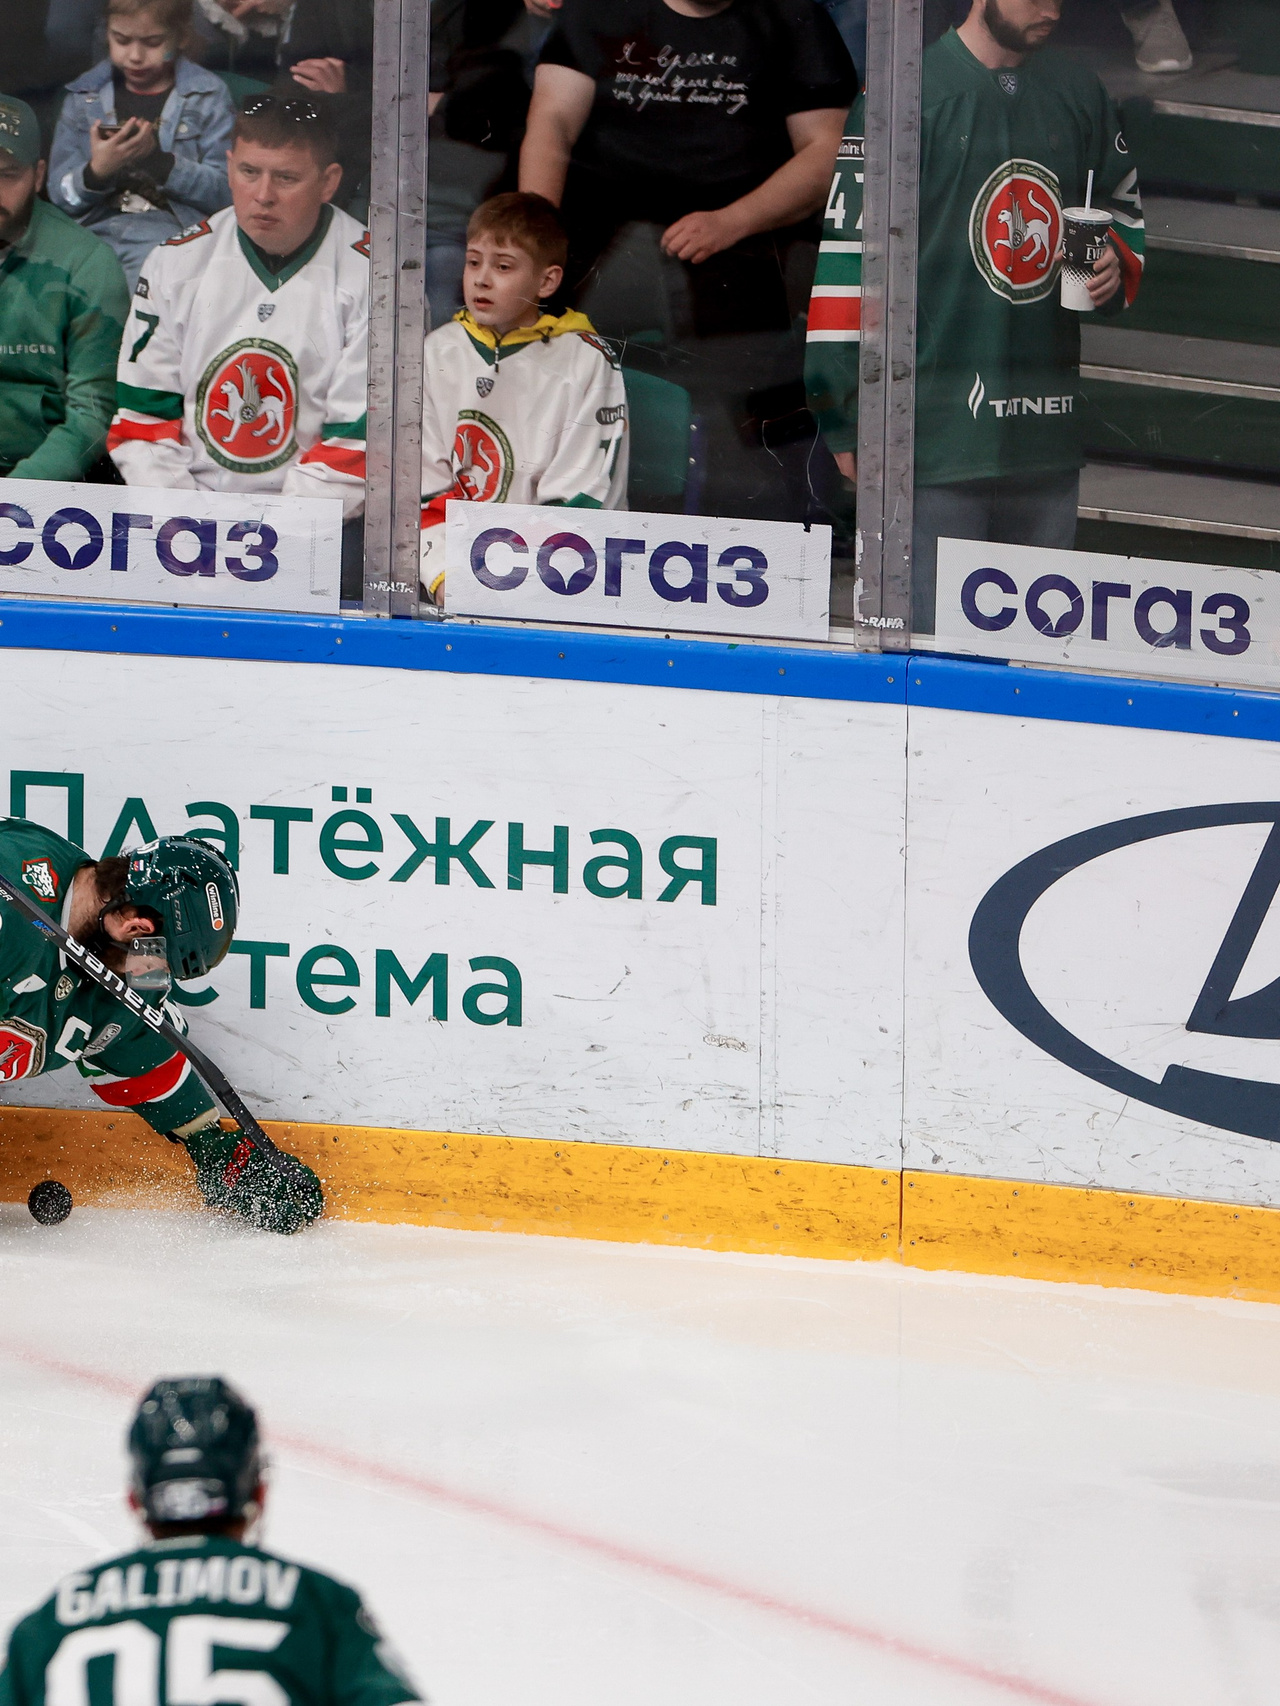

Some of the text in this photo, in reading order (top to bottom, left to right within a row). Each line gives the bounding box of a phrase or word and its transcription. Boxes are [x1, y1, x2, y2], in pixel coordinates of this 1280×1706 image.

[988, 395, 1073, 418] TATNEFT
[470, 527, 769, 609] согаз
[960, 566, 1251, 656] согаз
[10, 770, 719, 906] Платёжная
[66, 934, 165, 1027] BAUER
[163, 940, 523, 1027] тема
[54, 1555, 303, 1628] GALIMOV
